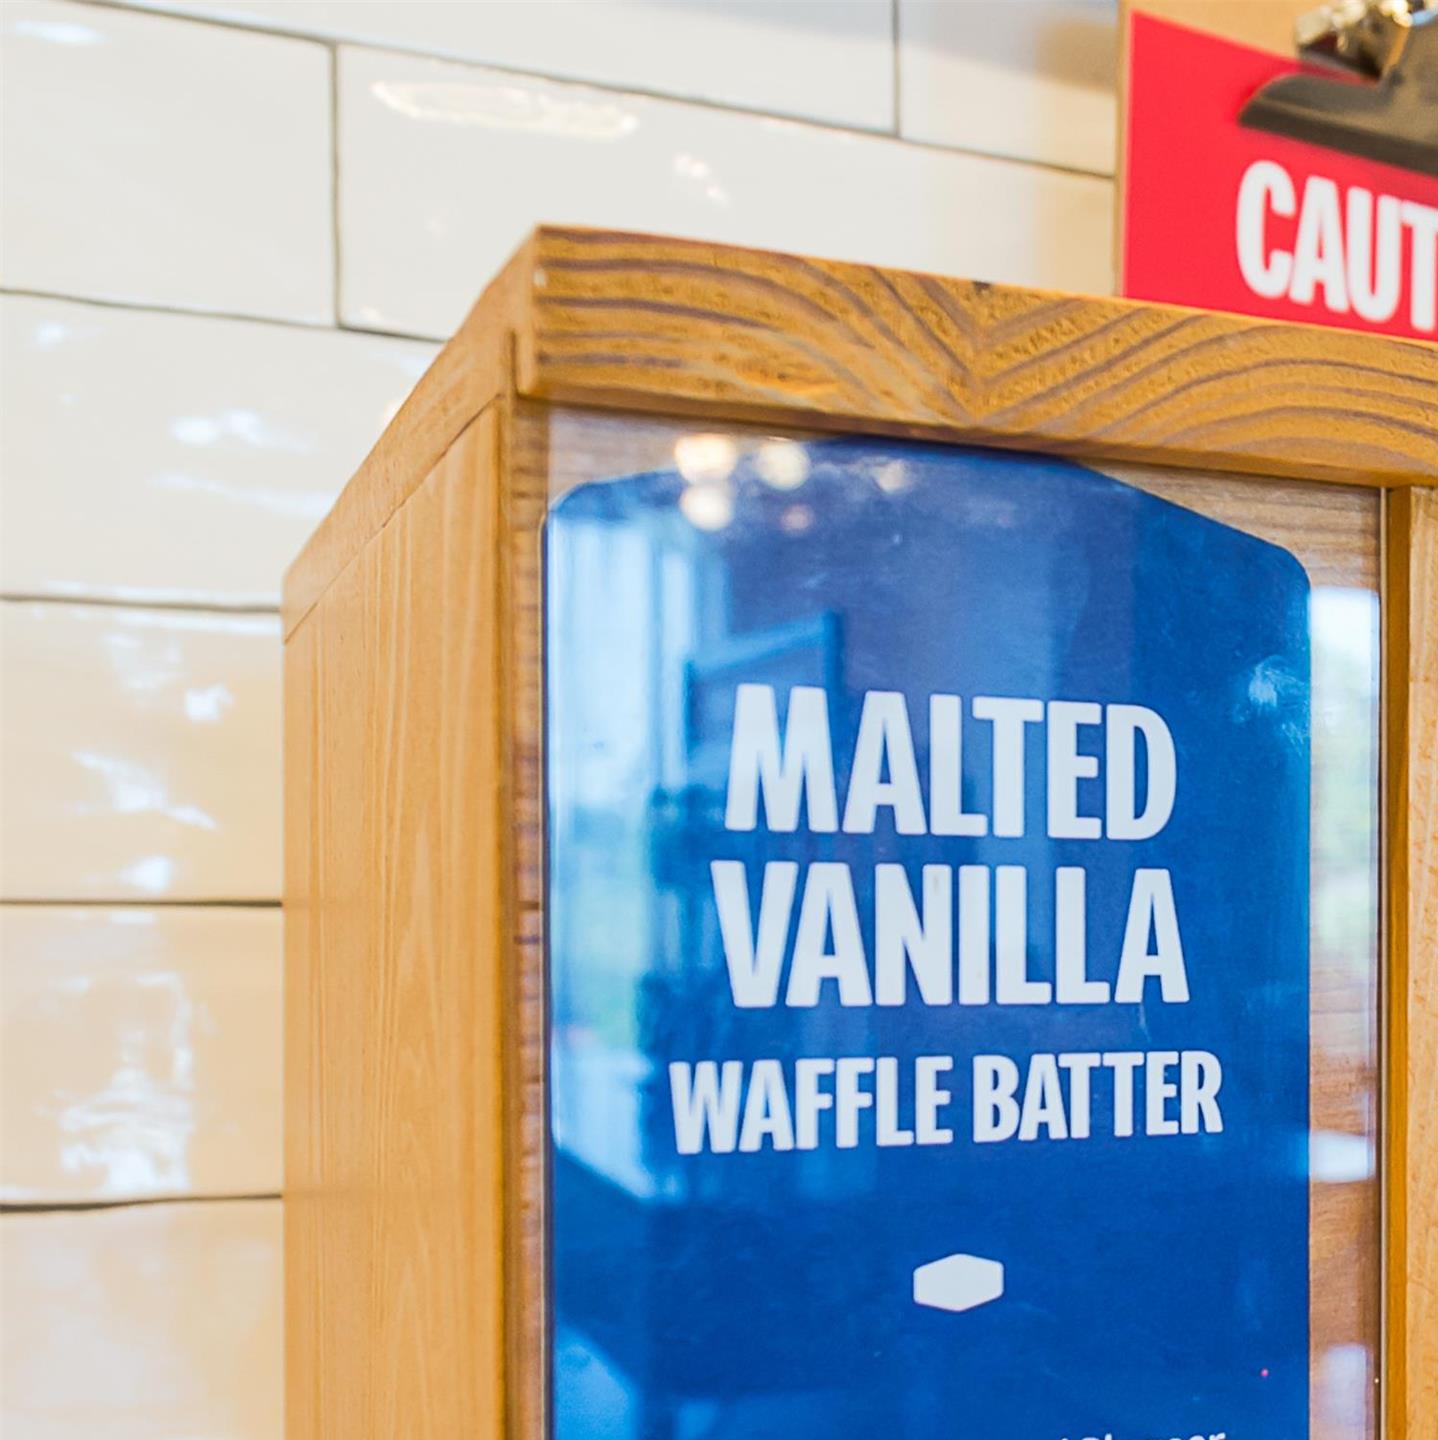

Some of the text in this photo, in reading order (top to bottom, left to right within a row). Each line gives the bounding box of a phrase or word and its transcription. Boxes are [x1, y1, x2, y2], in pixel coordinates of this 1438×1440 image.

[725, 683, 1176, 840] MALTED
[711, 860, 1189, 1008] VANILLA
[669, 1051, 1223, 1154] WAFFLE BATTER
